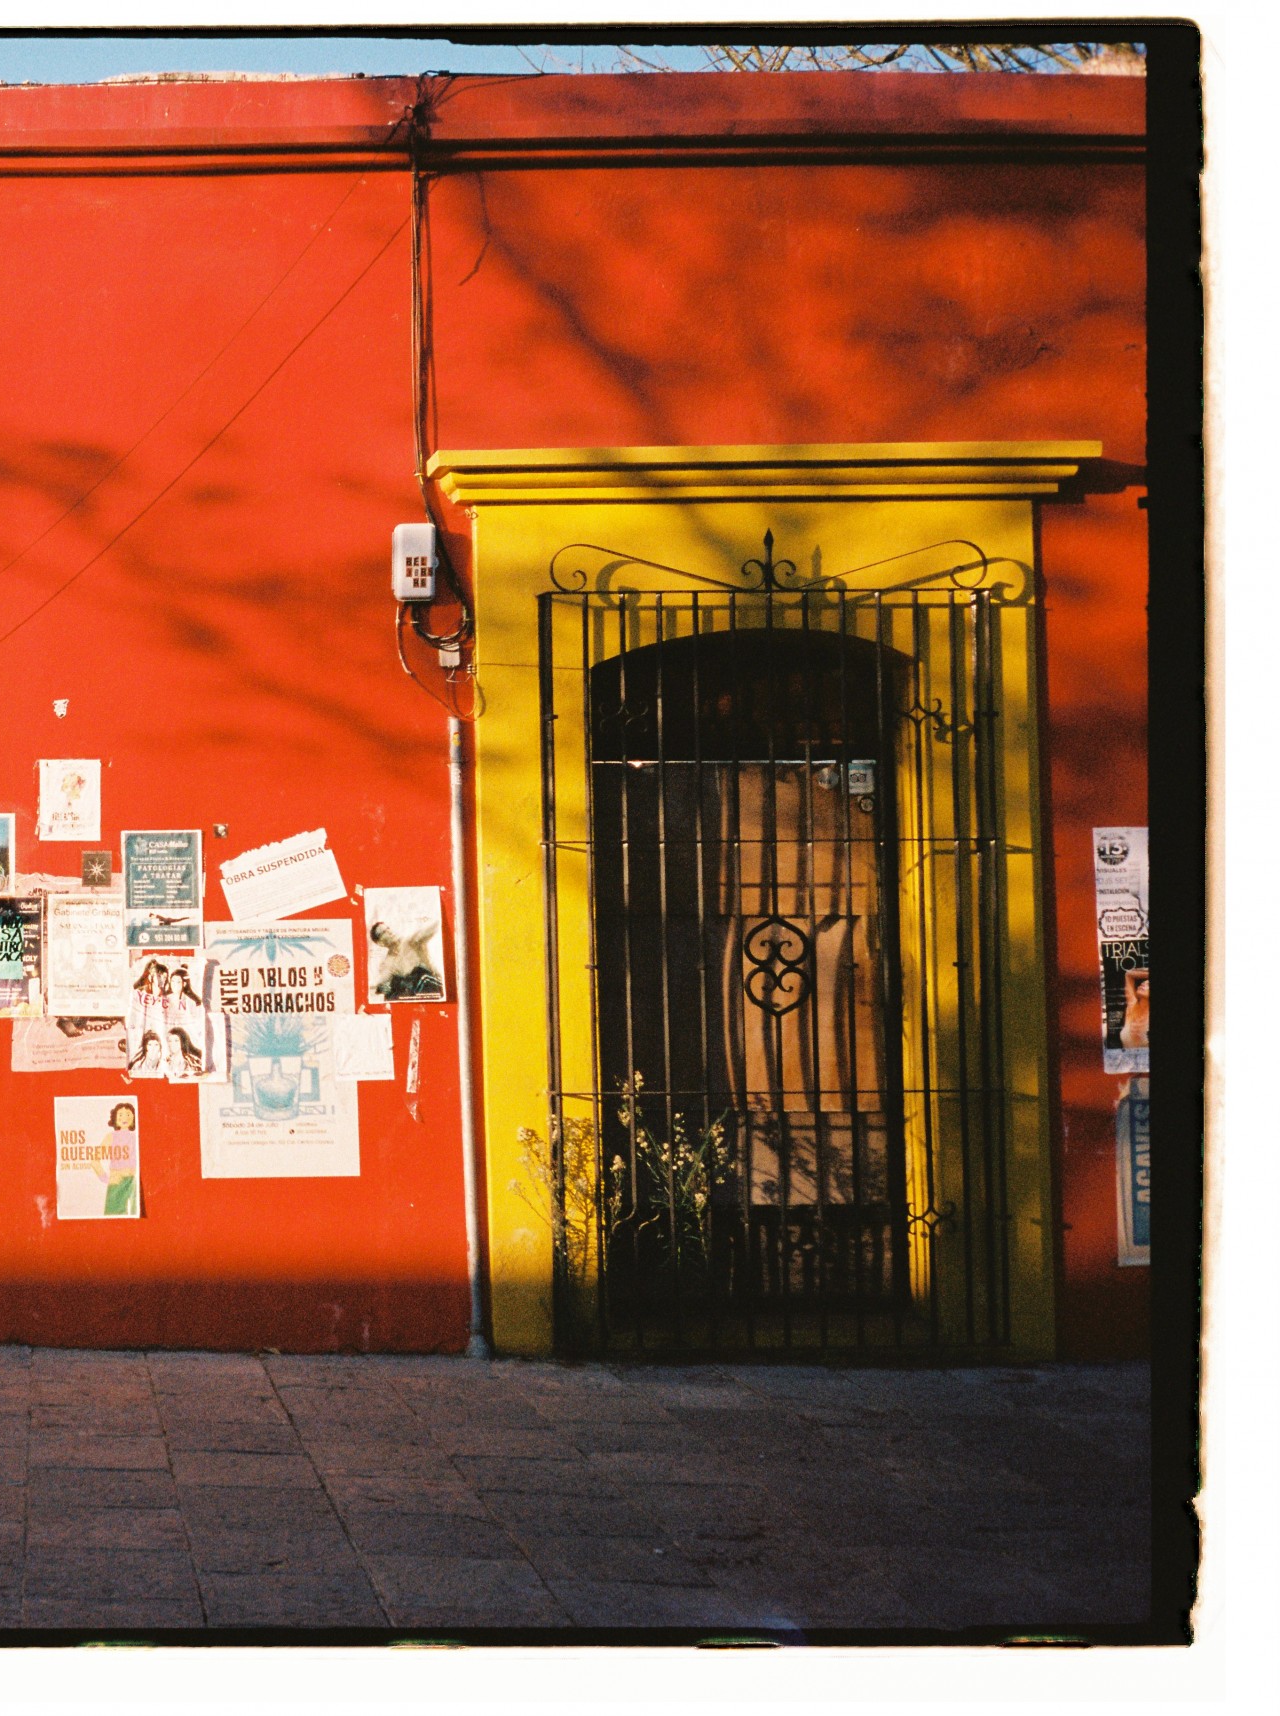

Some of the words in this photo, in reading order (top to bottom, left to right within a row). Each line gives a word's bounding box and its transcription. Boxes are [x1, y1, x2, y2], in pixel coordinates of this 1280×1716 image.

[226, 870, 255, 886] OBRA
[257, 846, 325, 875] SUSPENDIDA
[240, 966, 307, 988] DBLOS
[242, 991, 335, 1014] BORRACHOS
[61, 1130, 86, 1145] NOS
[61, 1145, 130, 1161] QUEREMOS
